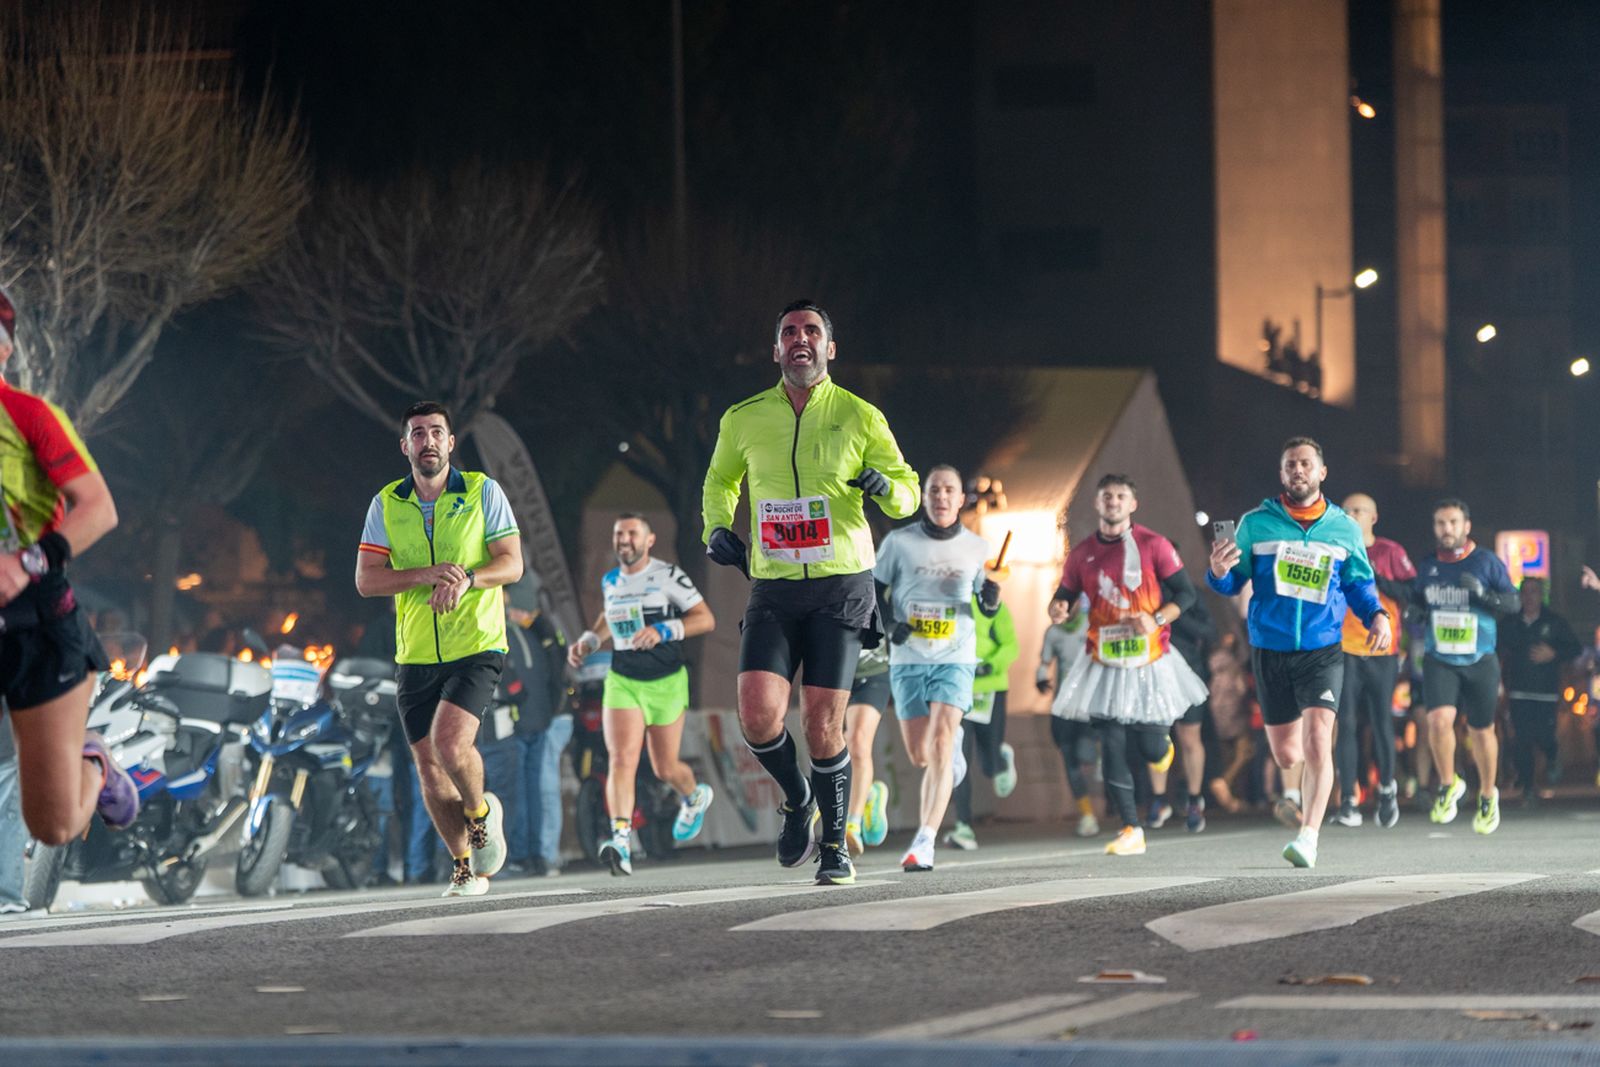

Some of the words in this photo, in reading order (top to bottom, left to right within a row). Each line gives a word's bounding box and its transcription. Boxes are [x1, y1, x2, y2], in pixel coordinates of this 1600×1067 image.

[774, 521, 818, 542] 8014
[1287, 563, 1321, 584] 1556
[916, 619, 949, 635] 8592
[832, 772, 848, 831] Kalenji
